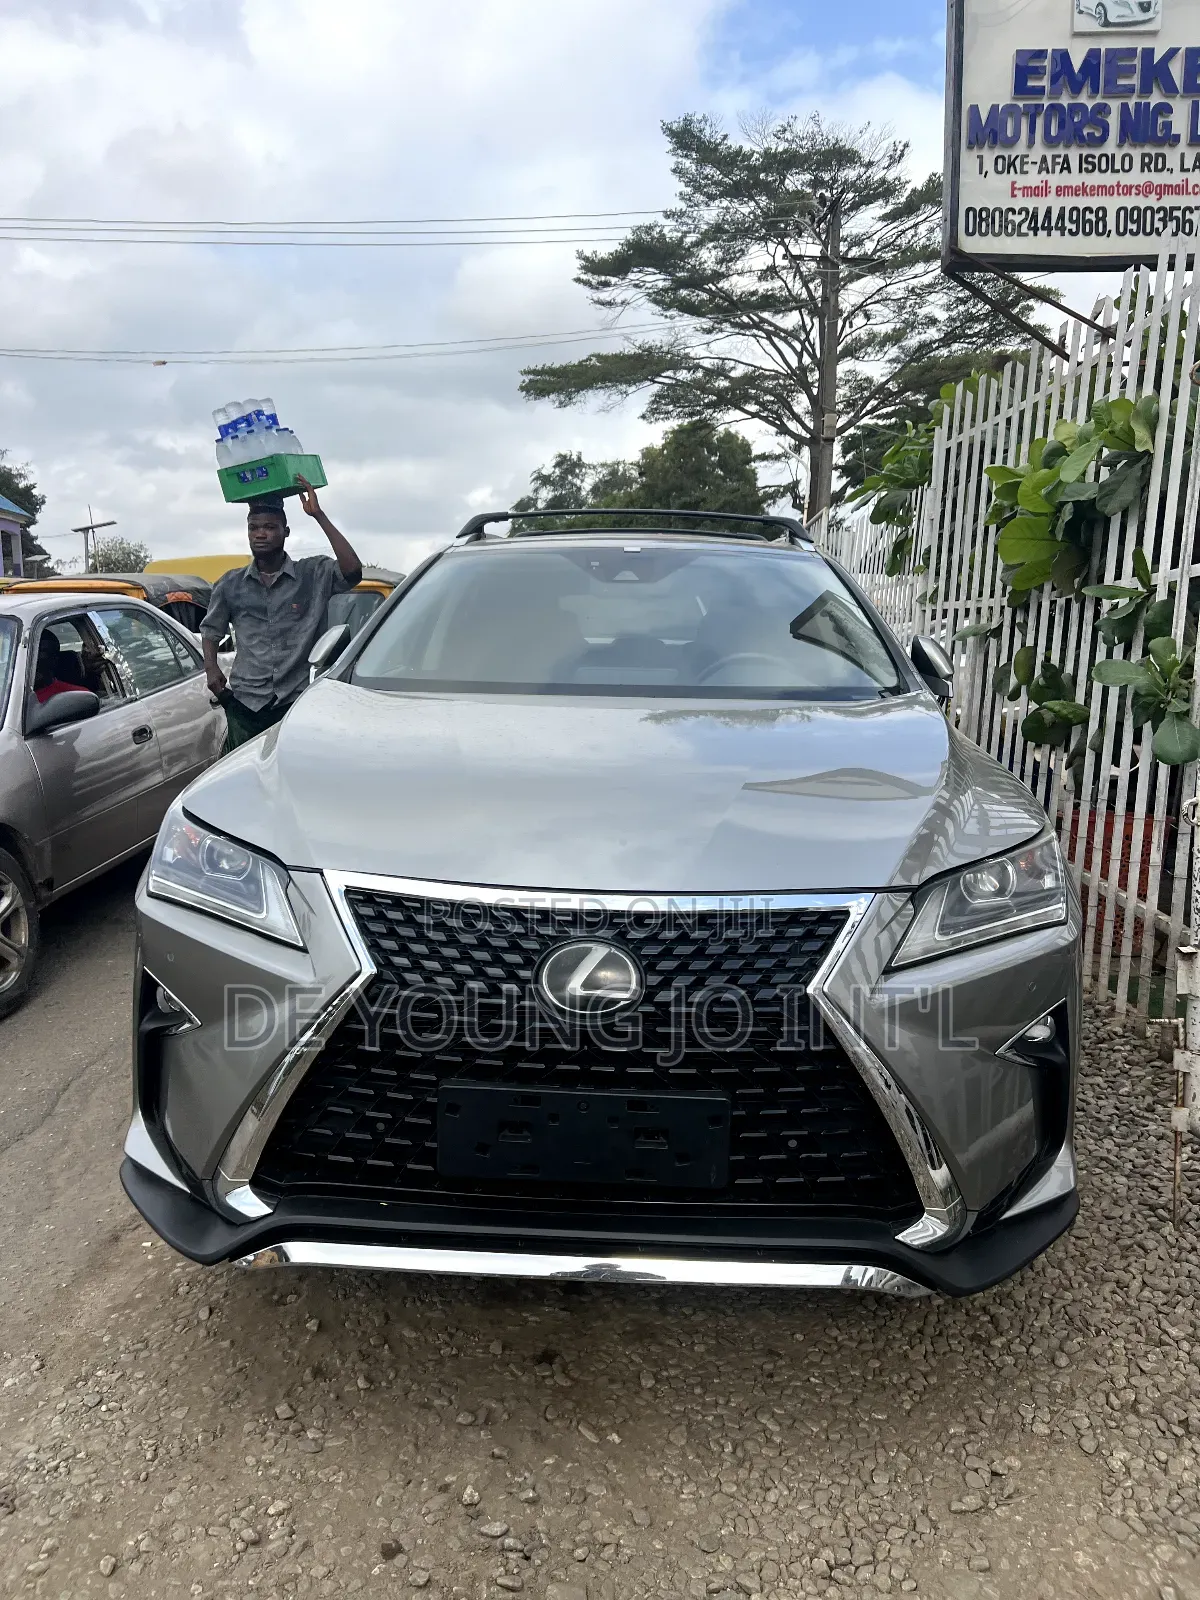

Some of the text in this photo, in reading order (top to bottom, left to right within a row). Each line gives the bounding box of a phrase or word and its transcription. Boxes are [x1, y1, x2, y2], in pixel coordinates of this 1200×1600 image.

[967, 102, 1112, 149] MOTORS
[1117, 101, 1181, 147] NIG.
[976, 154, 988, 178] 1,
[993, 153, 1072, 175] OKE-AFA
[1078, 152, 1134, 174] ISOLO
[1140, 152, 1174, 174] RD.,
[1010, 177, 1200, 202] E-mail: emekemotors@gmail.c
